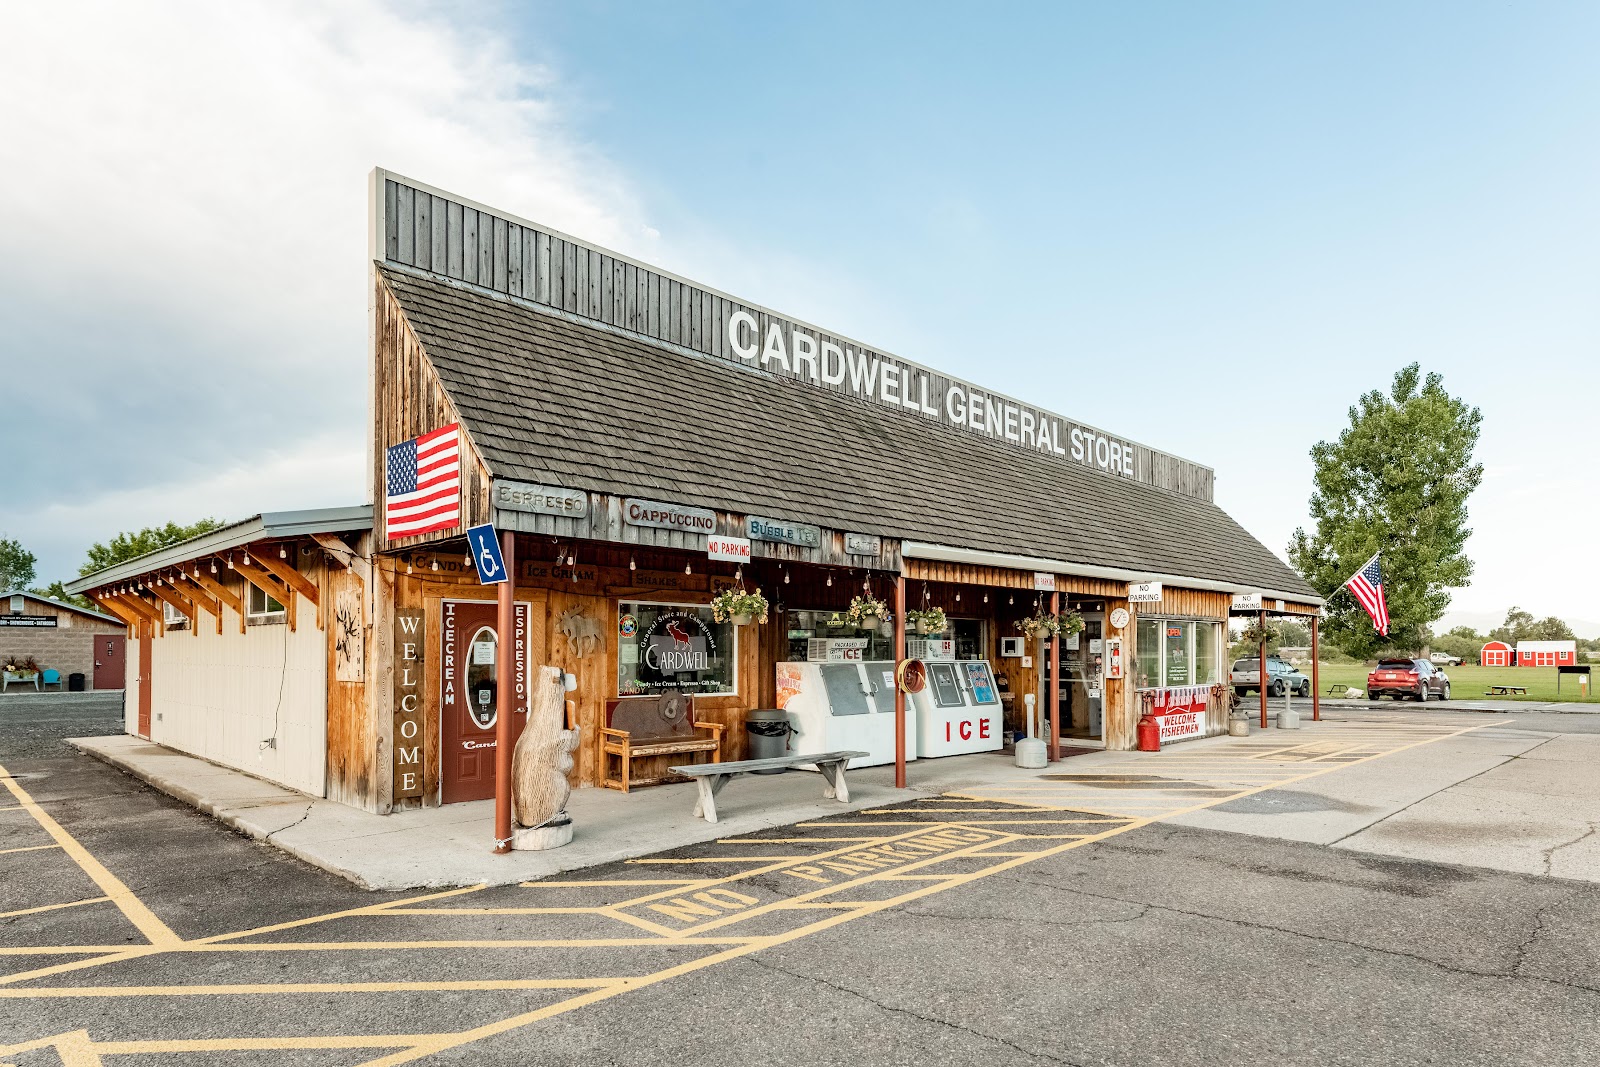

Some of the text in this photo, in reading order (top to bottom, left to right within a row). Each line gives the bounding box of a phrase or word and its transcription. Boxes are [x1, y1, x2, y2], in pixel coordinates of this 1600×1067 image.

[729, 311, 1134, 476] CARDWELL GENERAL STORE
[497, 485, 584, 513] ESPRESSO
[628, 503, 714, 530] CAPPUCCINO
[750, 520, 794, 540] BUBBLE
[708, 541, 750, 557] NO PARKING
[527, 563, 548, 577] ICE
[636, 573, 677, 587] SHAKES
[1139, 584, 1150, 592] NO
[1129, 593, 1159, 601] PARKING
[640, 620, 658, 648] General
[657, 612, 675, 623] Store
[676, 609, 688, 617] and
[688, 613, 717, 649] Campground
[1167, 628, 1181, 637] OPEN
[515, 606, 524, 693] ESPRESSO
[843, 648, 860, 660] ICE
[942, 641, 951, 650] ICE
[645, 643, 711, 670] CARDWELL
[398, 616, 421, 791] WELCOME
[1164, 713, 1197, 726] WELCOME
[945, 718, 990, 742] ICE
[1161, 724, 1200, 737] FISHERMEN
[646, 829, 991, 923] NO PARKING
